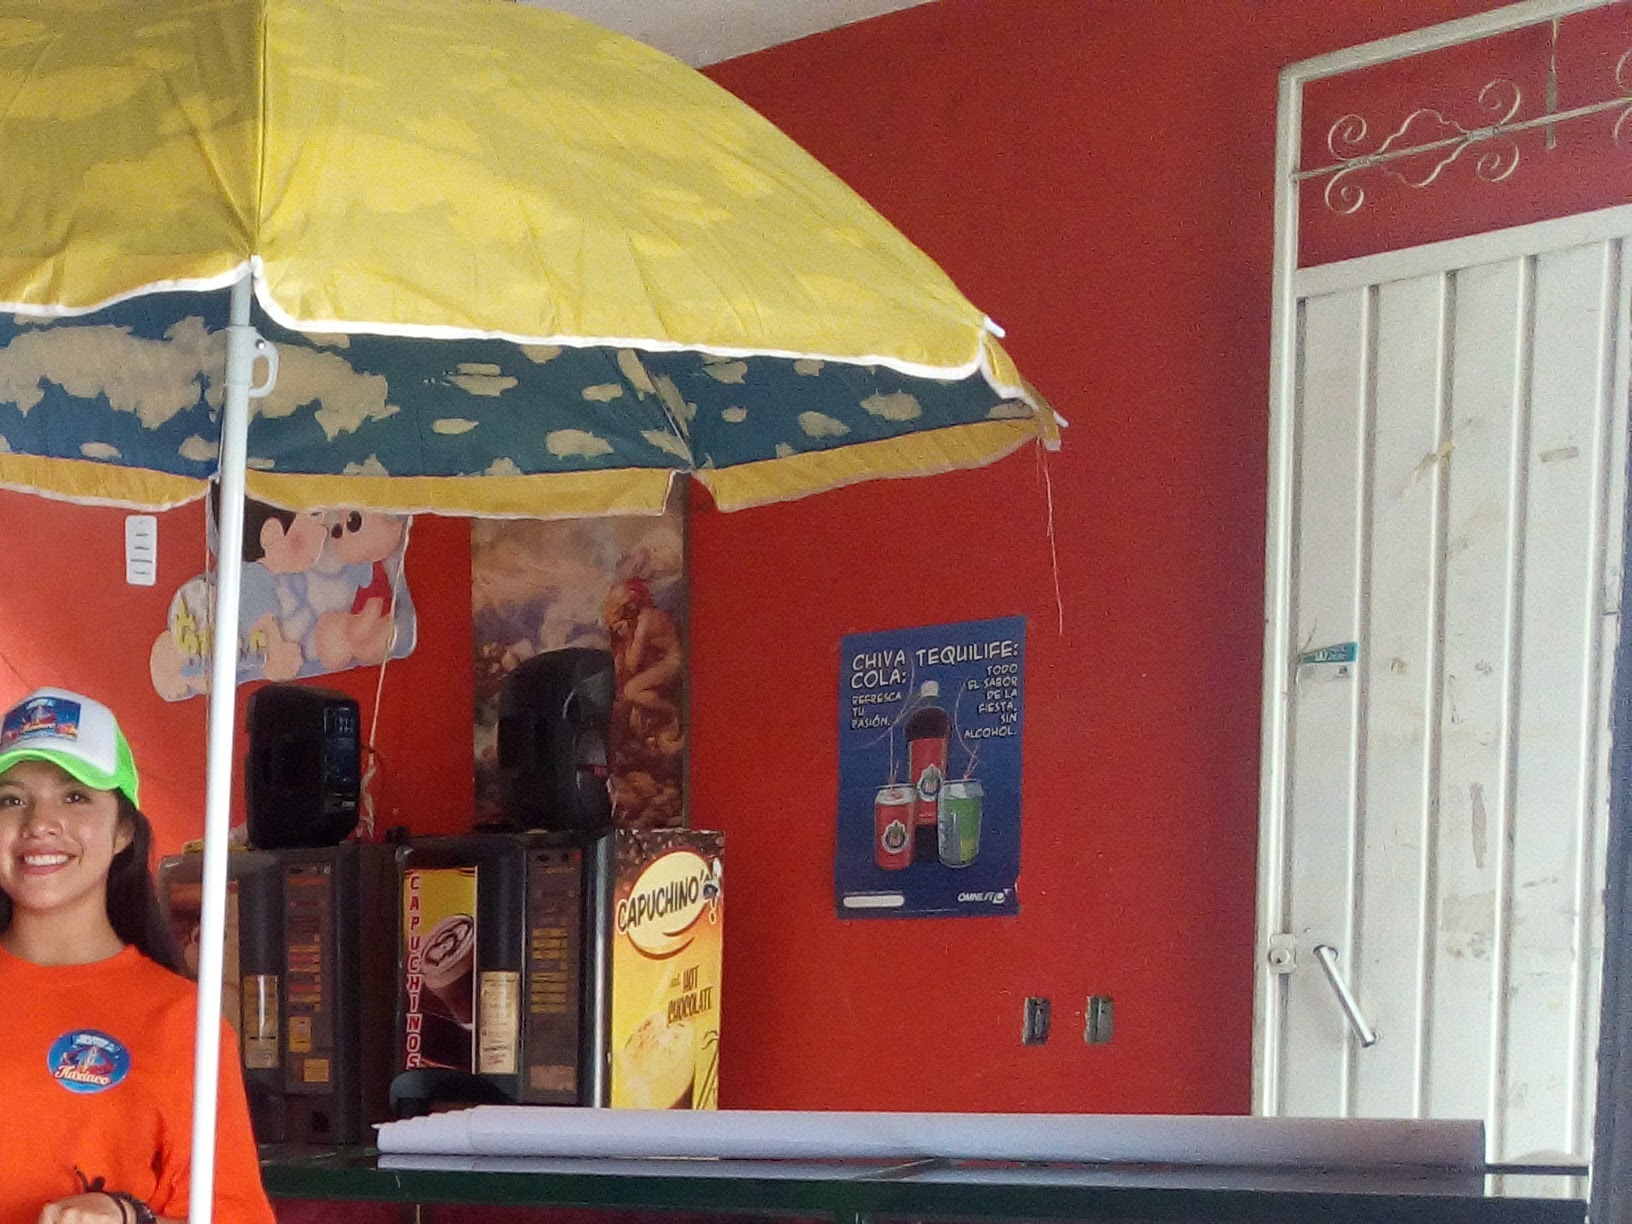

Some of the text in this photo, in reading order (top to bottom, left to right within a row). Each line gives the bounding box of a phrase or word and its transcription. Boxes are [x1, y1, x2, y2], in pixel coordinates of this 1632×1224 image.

[852, 640, 1019, 671] CHIVA TEQUILIFE:
[986, 663, 1018, 676] TODO
[850, 669, 908, 689] COLA:
[983, 677, 1018, 689] SABOR
[851, 692, 902, 705] REFRESCA
[986, 690, 1018, 701] DE LA
[852, 707, 865, 718] TU
[1000, 713, 1017, 724] SIN
[851, 714, 891, 730] PASIÓN.
